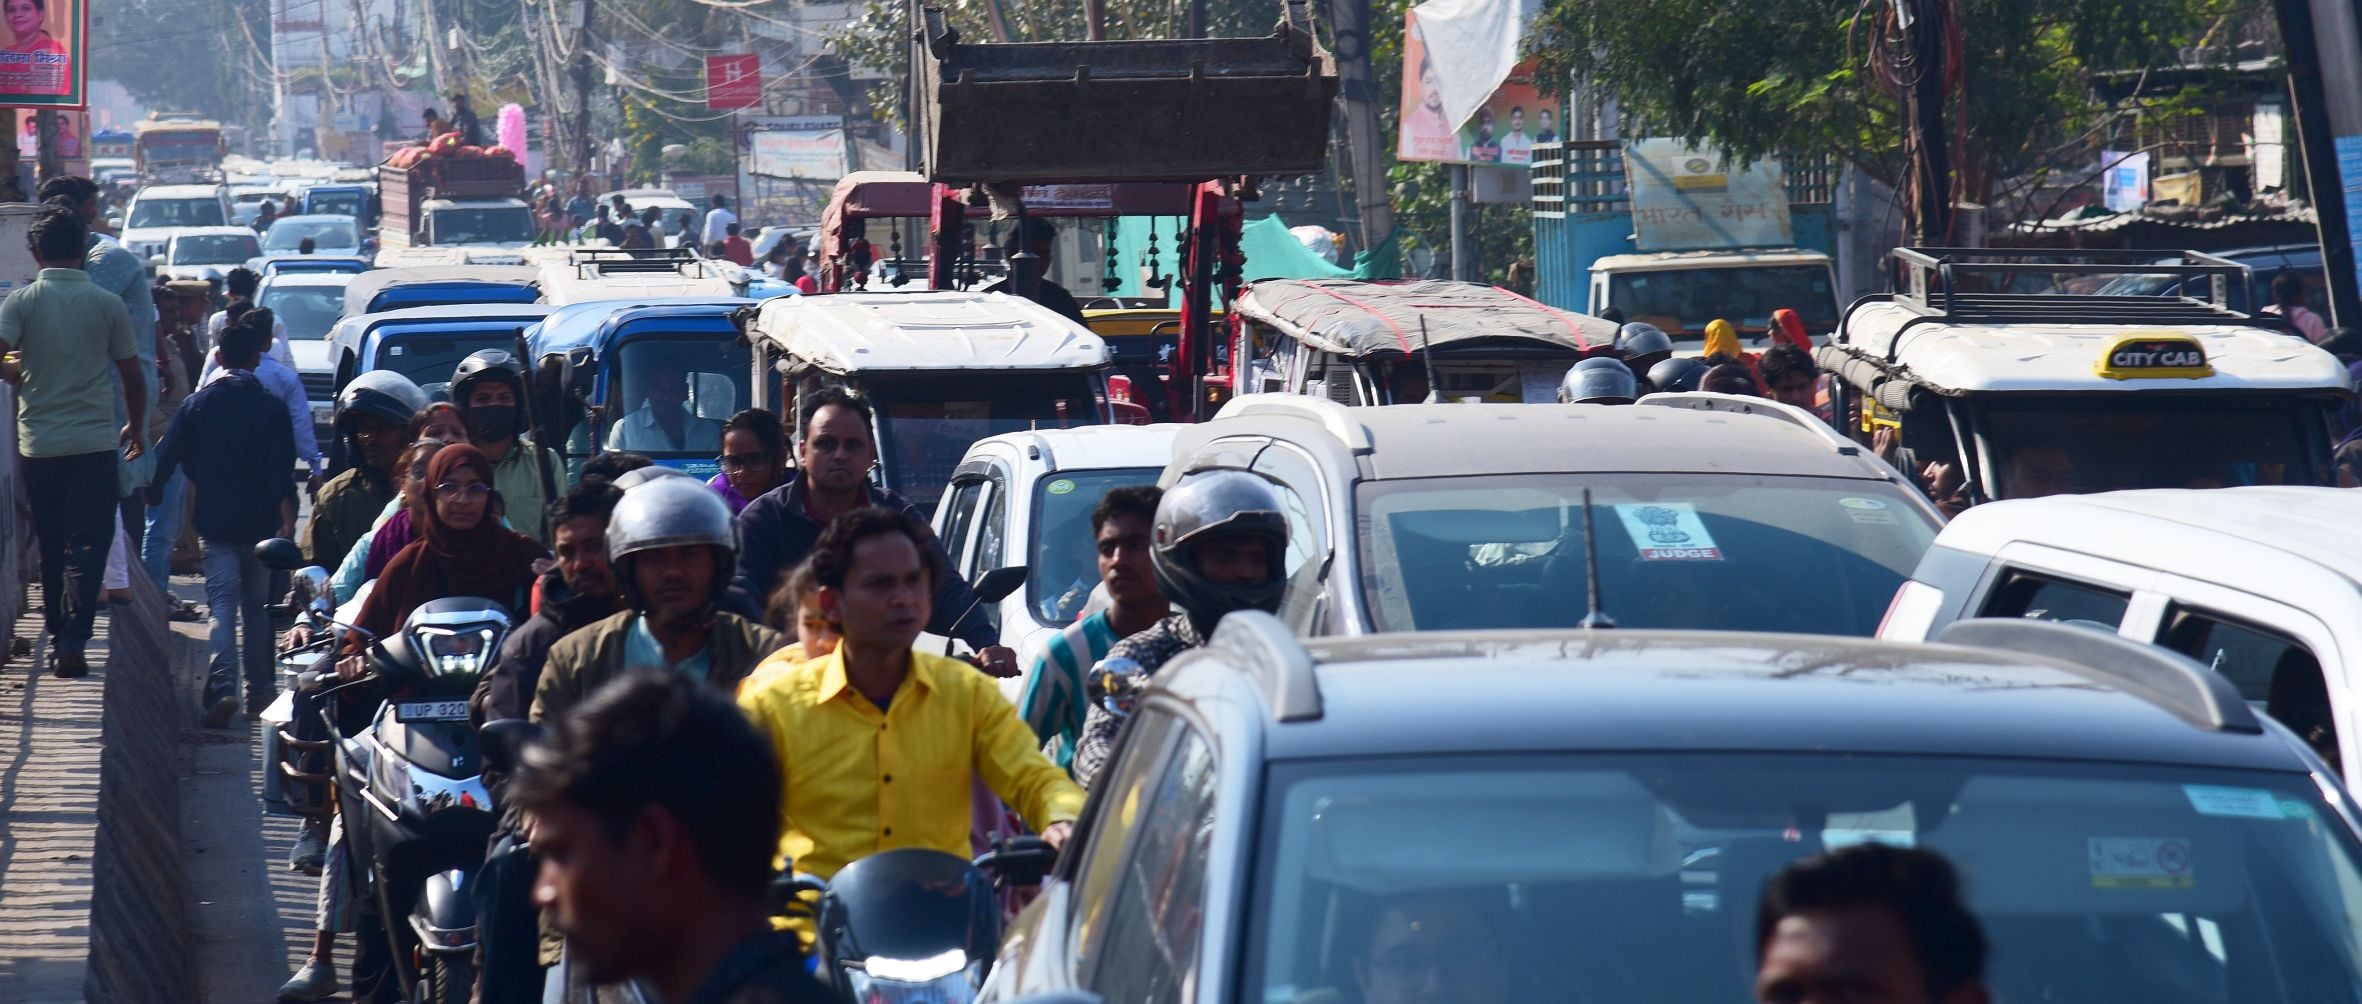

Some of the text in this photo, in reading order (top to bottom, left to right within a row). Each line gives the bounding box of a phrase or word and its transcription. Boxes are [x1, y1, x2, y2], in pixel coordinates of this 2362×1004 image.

[2113, 351, 2201, 367] CITY CAB
[1648, 549, 1717, 559] JUDGE
[415, 704, 432, 717] UP
